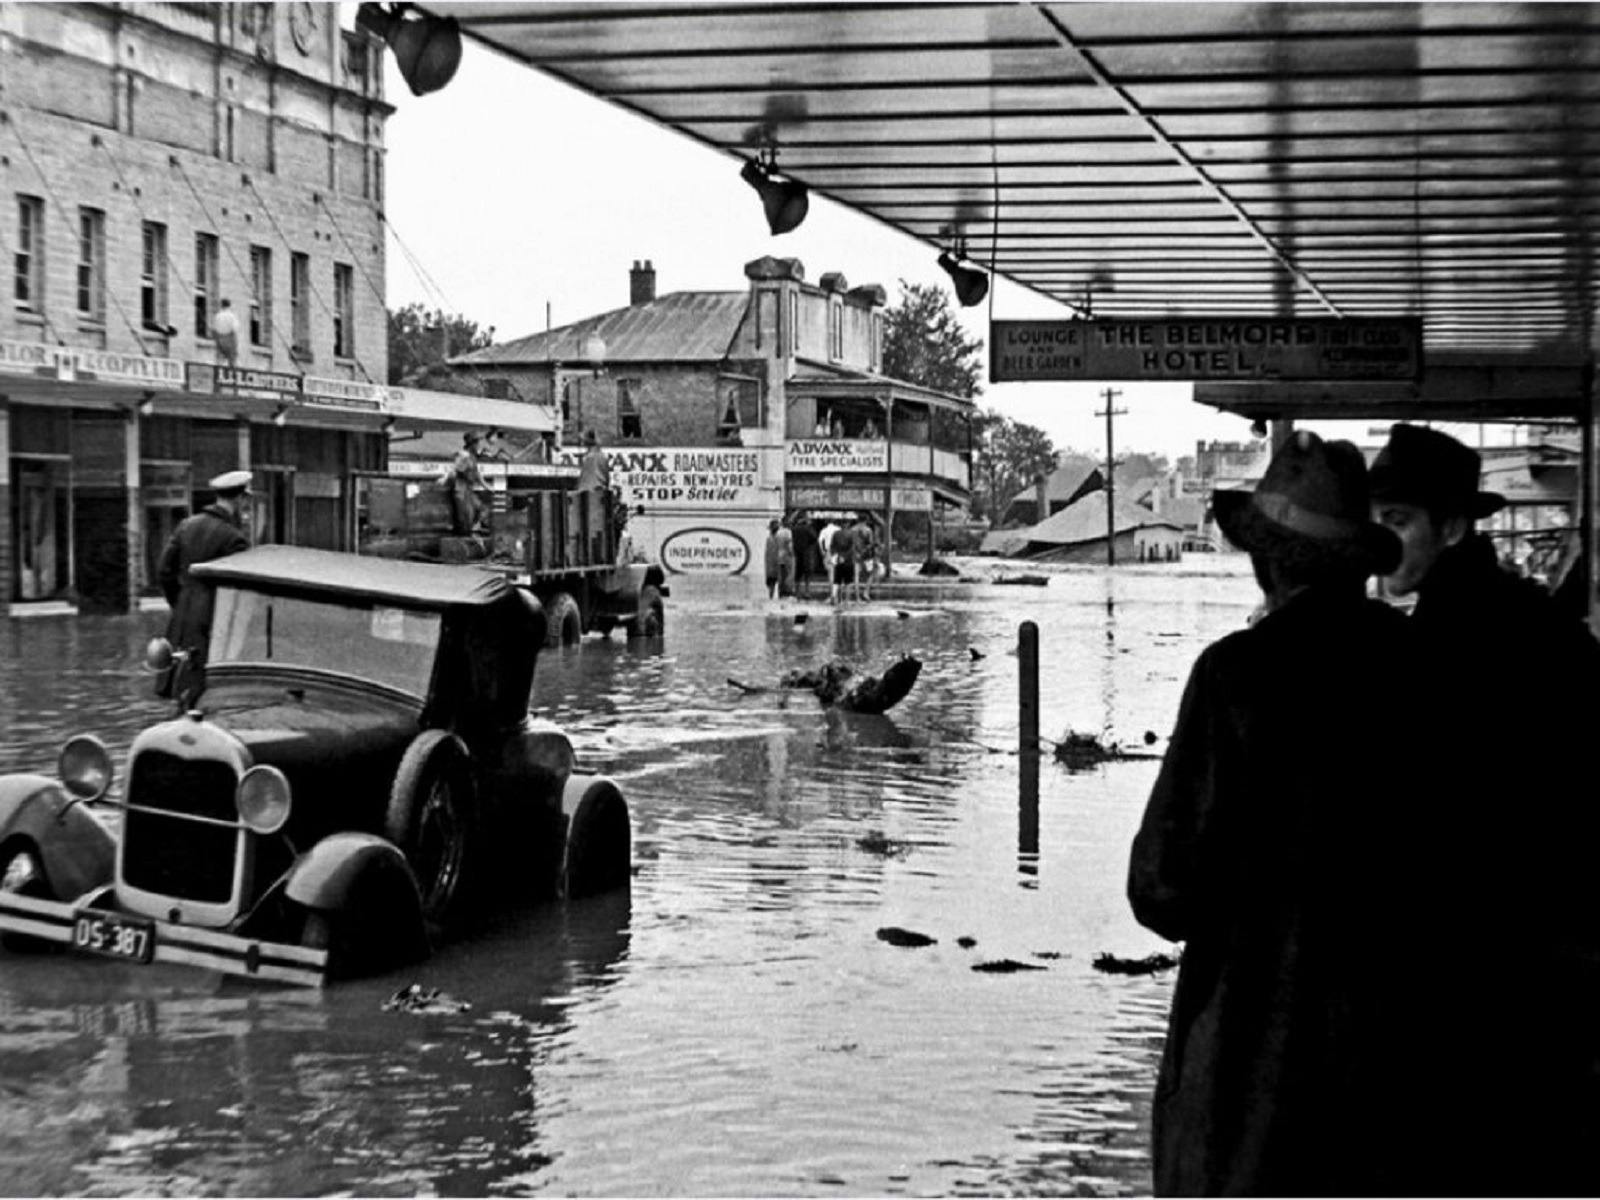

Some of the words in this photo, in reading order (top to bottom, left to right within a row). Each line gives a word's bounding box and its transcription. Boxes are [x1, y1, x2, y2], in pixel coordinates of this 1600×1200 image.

[1008, 329, 1077, 345] LOUNGE
[1098, 325, 1153, 345] THE
[1029, 346, 1055, 354] AND
[1142, 351, 1256, 371] HOTEL
[790, 442, 853, 455] ADVANX
[674, 453, 758, 472] ROADMASTERS
[792, 456, 816, 467] TYRE
[820, 456, 883, 467] SPECIALISTS
[628, 473, 676, 487] REPAIRS
[683, 473, 708, 487] NEW
[714, 473, 753, 487] TYRES
[633, 487, 683, 500] STOP
[687, 486, 739, 501] Service
[668, 547, 742, 560] INDEPENDENT
